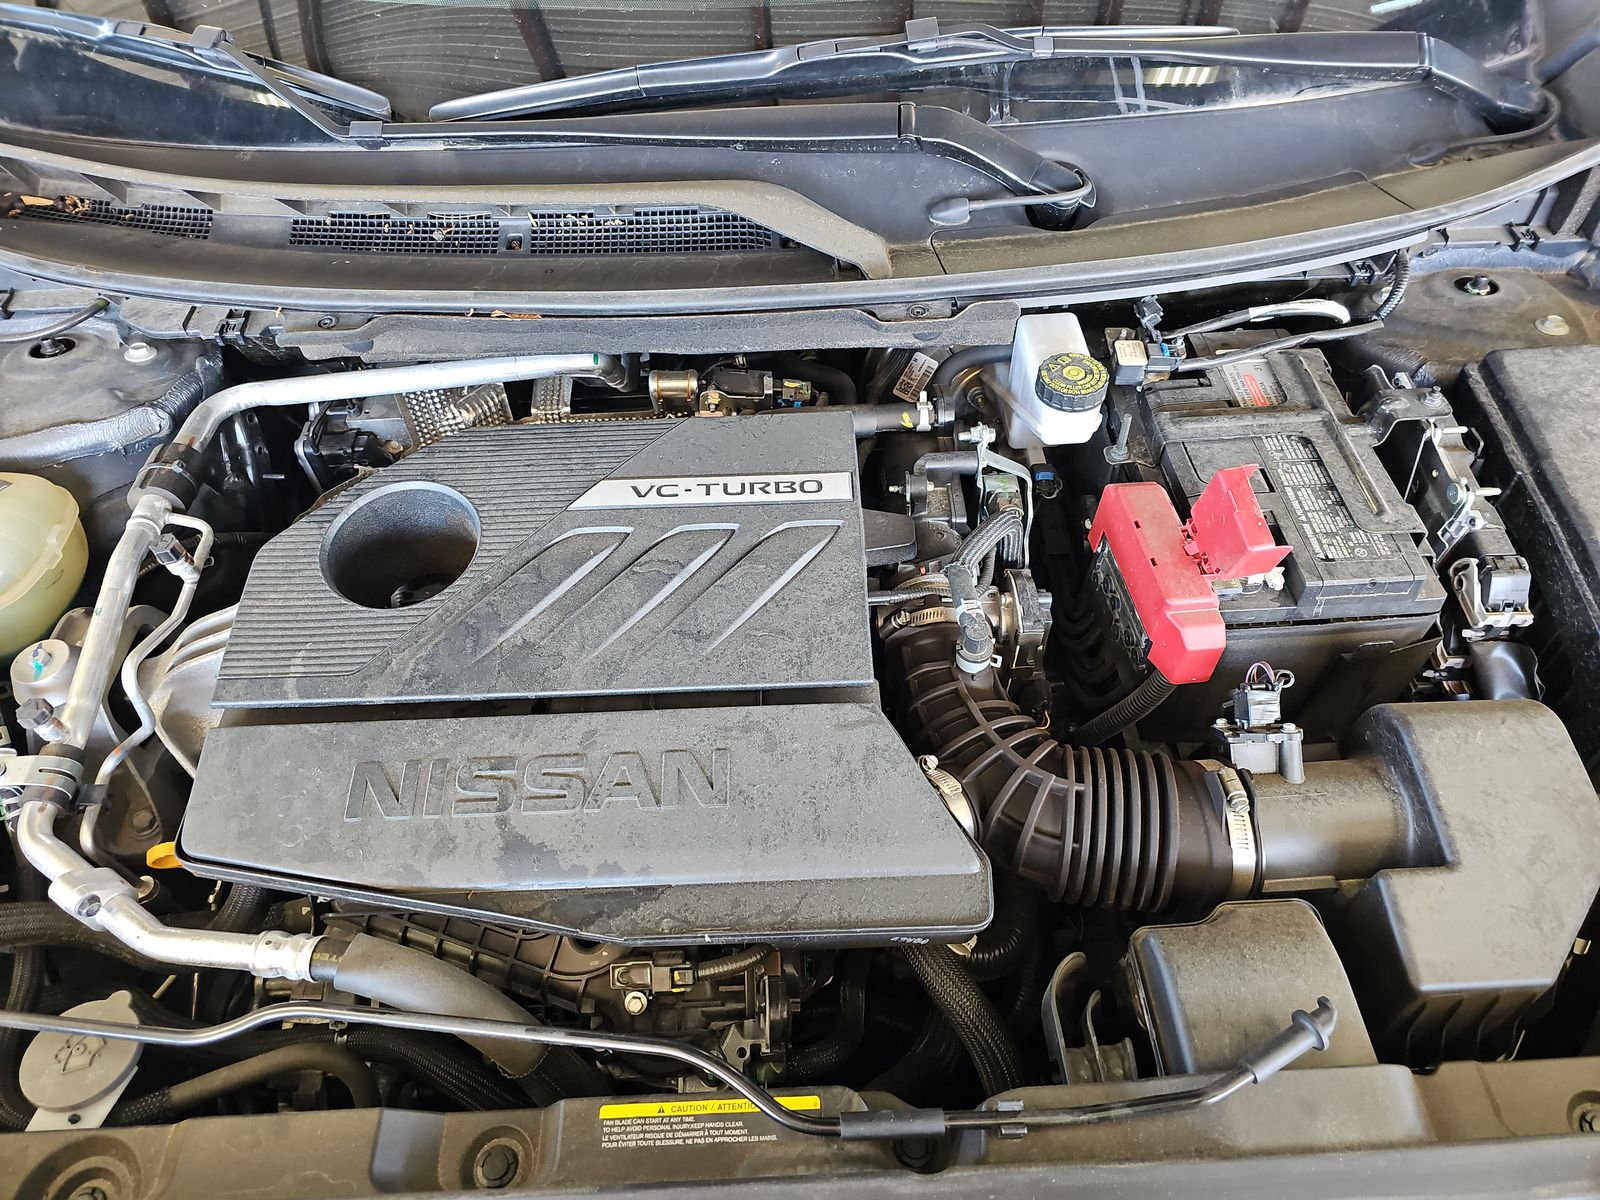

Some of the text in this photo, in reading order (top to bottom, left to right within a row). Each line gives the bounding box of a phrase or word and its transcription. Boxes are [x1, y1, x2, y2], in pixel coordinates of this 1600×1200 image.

[630, 479, 823, 498] VC-TURBO
[343, 747, 732, 823] NISSAN
[671, 1104, 708, 1113] CAUTION
[717, 1102, 757, 1111] ATTENTIO
[643, 1123, 671, 1131] PERSONAL
[610, 1133, 644, 1141] VENTILATEUR
[674, 1130, 703, 1138] DÉMARRER
[618, 1140, 636, 1148] ÉVITER
